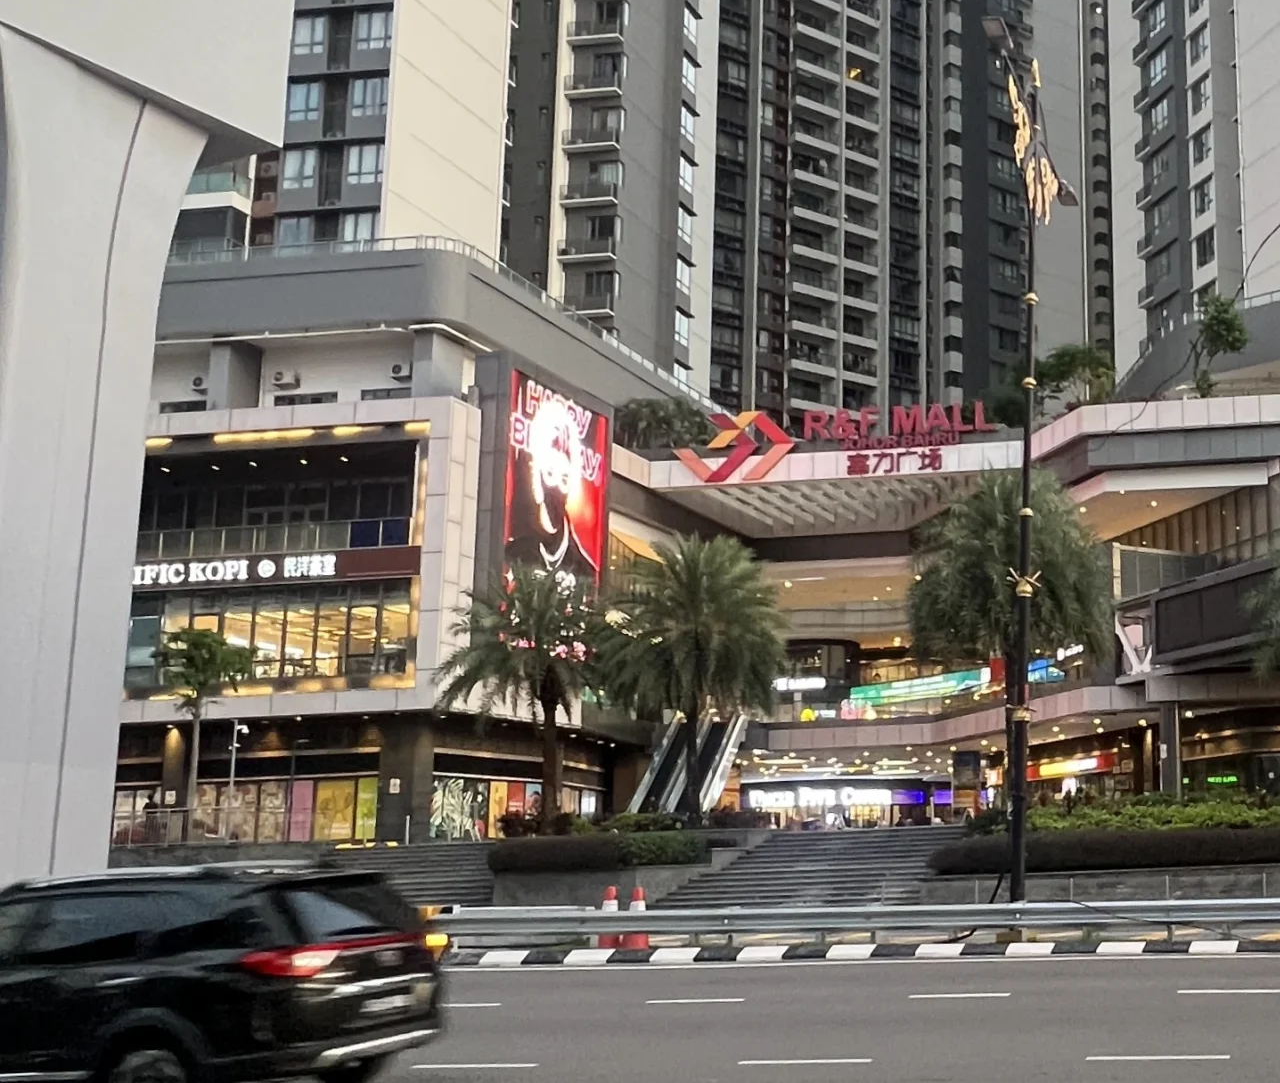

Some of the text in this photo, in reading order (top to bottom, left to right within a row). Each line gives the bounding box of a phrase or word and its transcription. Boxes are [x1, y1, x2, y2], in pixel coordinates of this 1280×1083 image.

[803, 400, 999, 440] R&F MALL
[840, 432, 959, 450] JOHOR BAHRU
[847, 449, 943, 476] 富力广场
[188, 559, 249, 582] KOPI
